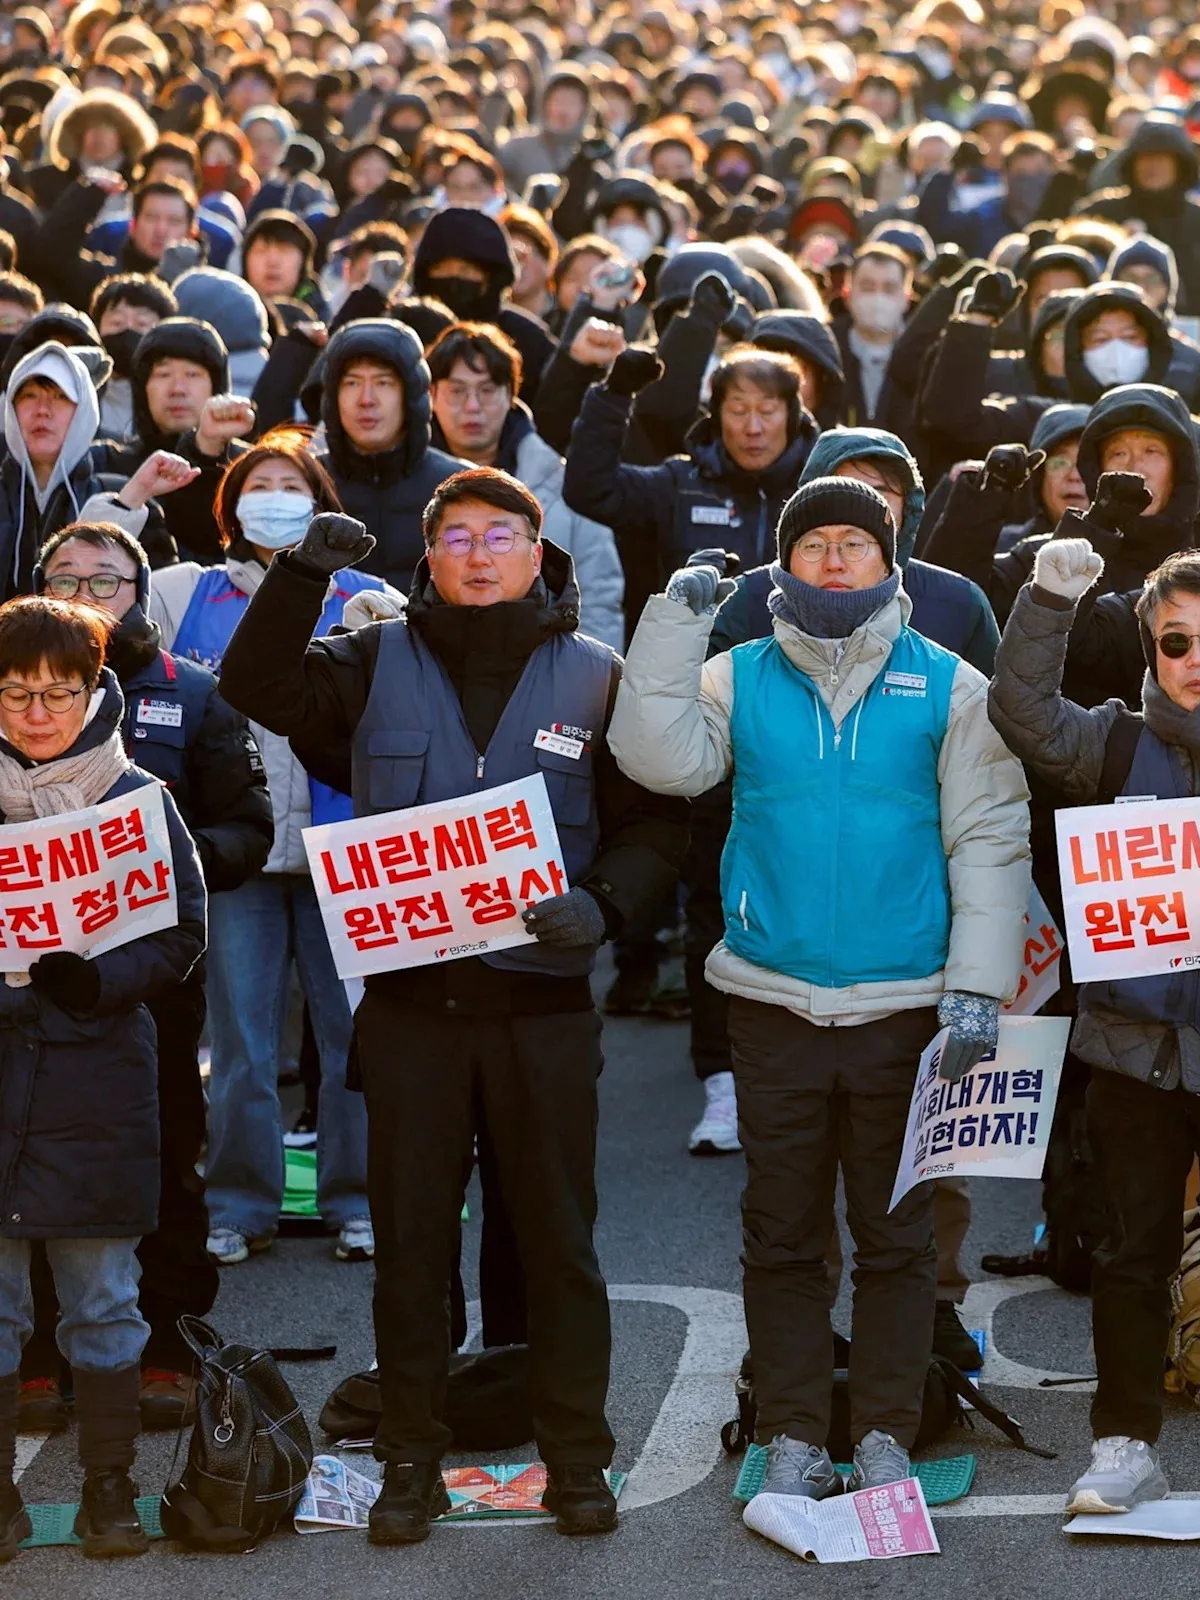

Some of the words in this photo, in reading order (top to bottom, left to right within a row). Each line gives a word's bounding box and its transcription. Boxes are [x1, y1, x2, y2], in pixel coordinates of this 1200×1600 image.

[0, 807, 147, 892] 란세력
[321, 799, 537, 895] 내란세력
[0, 902, 62, 949] 전
[72, 860, 170, 935] 청산
[344, 891, 453, 951] 완전
[1085, 891, 1190, 953] 완전
[450, 940, 488, 955] 민주노총
[1016, 924, 1062, 998] 산
[912, 1069, 1043, 1138] 사회대개혁
[913, 1112, 1039, 1169] 실현하자!
[926, 1162, 955, 1175] 민주노총
